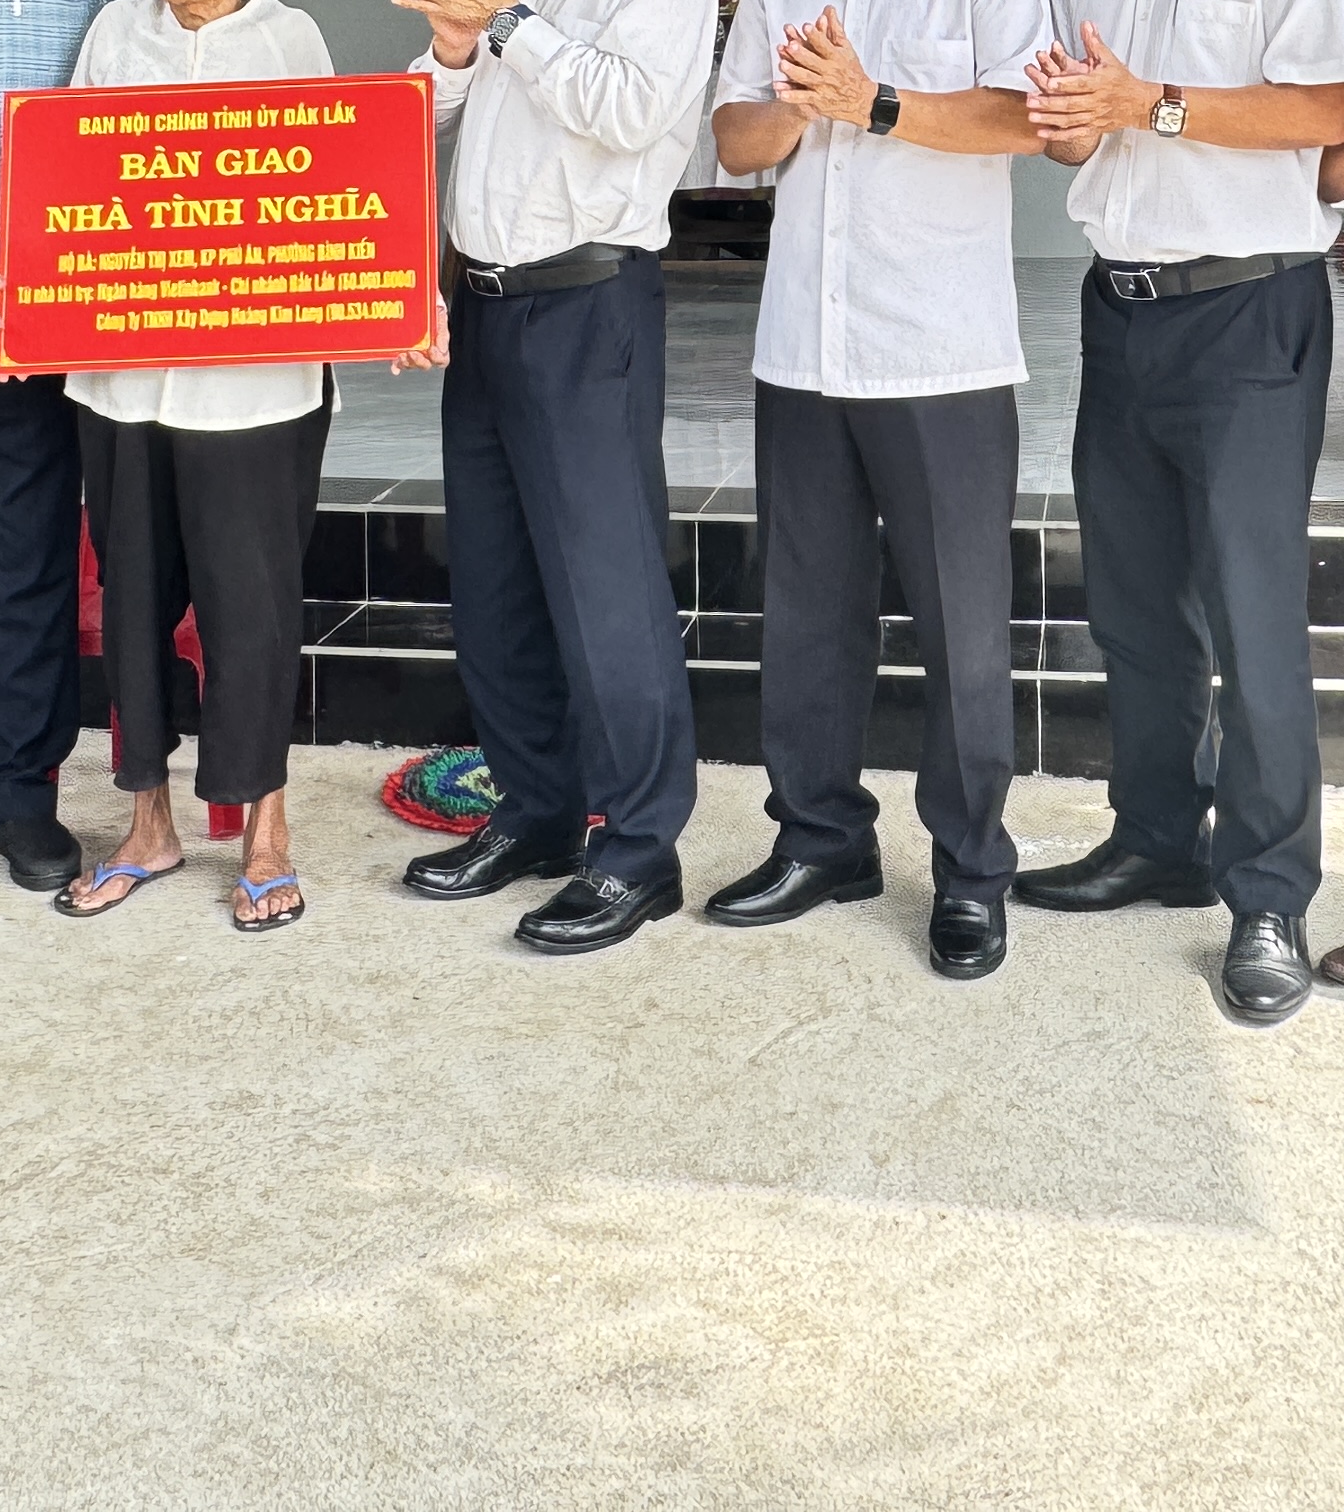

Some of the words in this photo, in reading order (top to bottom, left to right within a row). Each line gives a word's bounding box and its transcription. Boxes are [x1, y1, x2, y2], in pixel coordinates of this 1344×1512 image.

[78, 115, 116, 136] BAN
[119, 111, 151, 137] NỘI
[154, 109, 209, 133] CHÍNH
[212, 105, 253, 130] TỈNH
[256, 103, 280, 128] ỦY
[119, 145, 203, 181] BÀN
[215, 145, 313, 177] GIAO
[45, 196, 133, 233] NHÀ
[144, 193, 245, 229] TÌNH
[256, 187, 389, 224] NGHĨA
